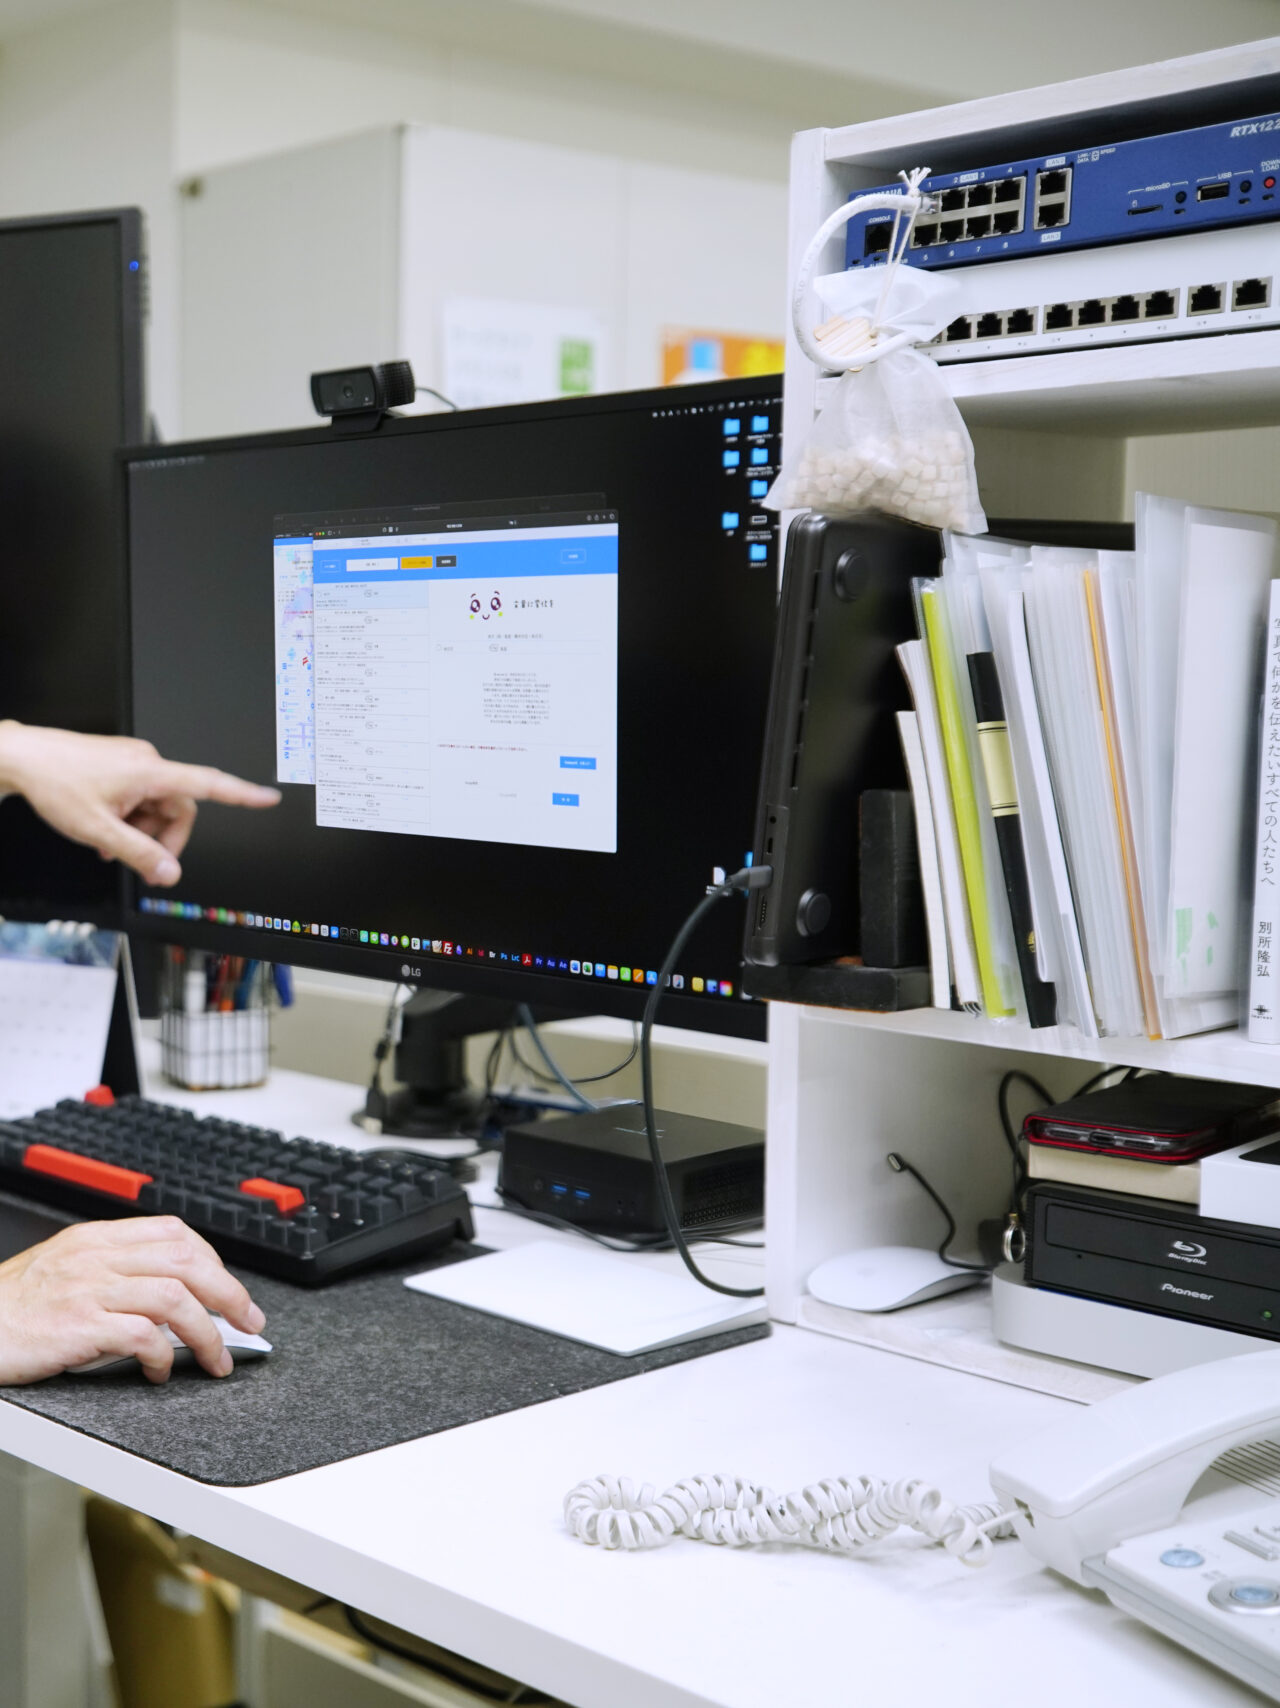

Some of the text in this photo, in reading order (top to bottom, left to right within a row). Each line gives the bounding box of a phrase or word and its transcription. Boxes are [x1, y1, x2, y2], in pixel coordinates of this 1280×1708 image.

[1262, 164, 1279, 172] LOAD
[953, 176, 959, 184] 2
[980, 171, 985, 179] 3
[1007, 166, 1013, 174] 4
[1217, 171, 1232, 180] USB
[1145, 182, 1171, 192] microSD
[868, 214, 891, 224] CONSOLE
[1257, 921, 1272, 977] 別所隆弘
[410, 967, 422, 977] LG
[1161, 1283, 1215, 1300] Pioneer
